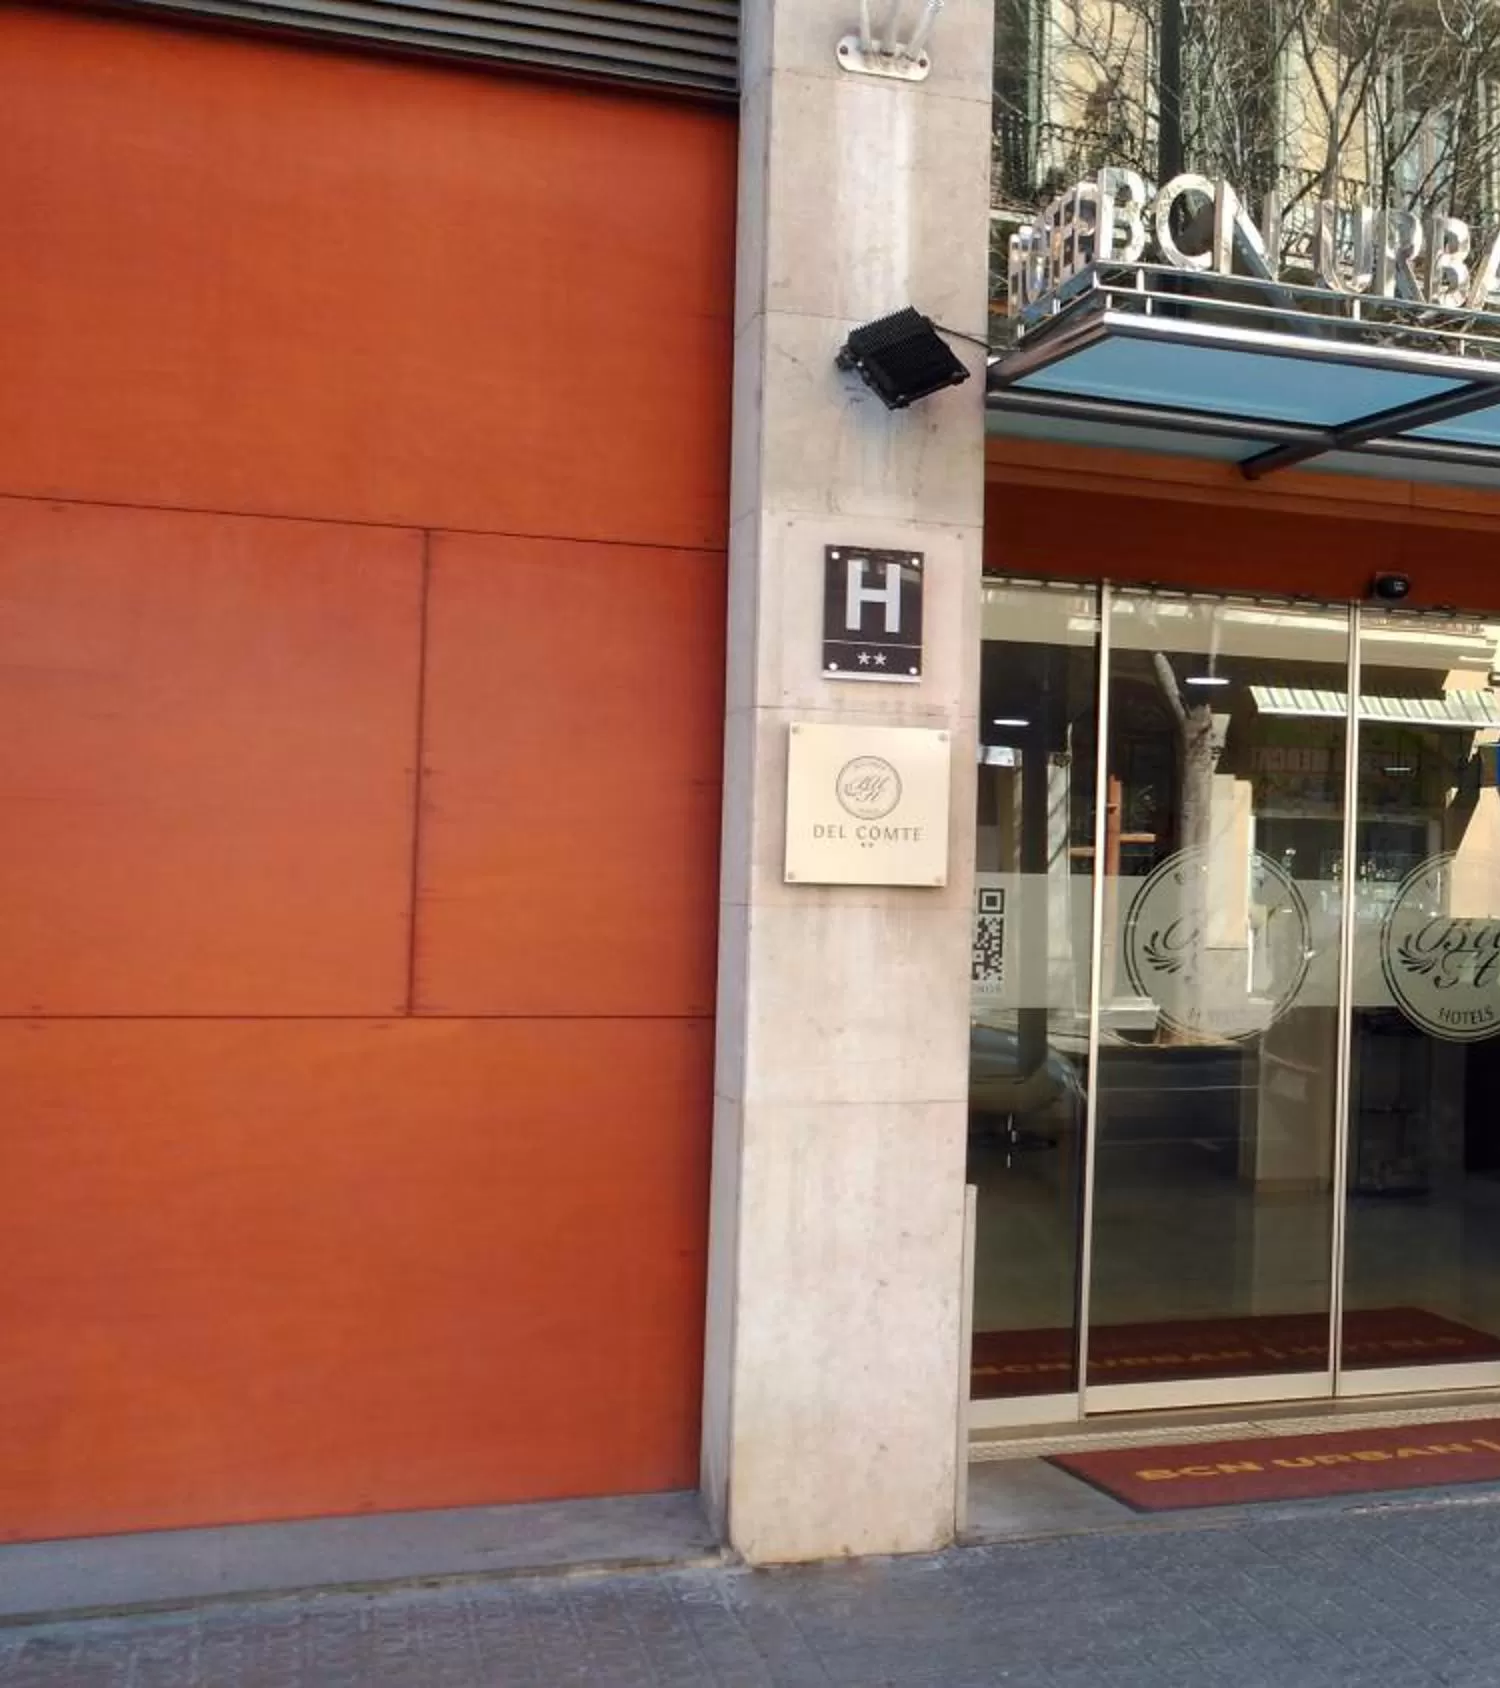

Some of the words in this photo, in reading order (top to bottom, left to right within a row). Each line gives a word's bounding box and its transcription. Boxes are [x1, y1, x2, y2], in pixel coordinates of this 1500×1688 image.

[1097, 167, 1281, 283] BCN
[845, 559, 900, 633] H
[813, 823, 847, 839] DEL
[855, 824, 924, 841] COMTE
[1438, 1003, 1495, 1026] HOTELS
[1136, 1460, 1265, 1481] BCN
[1271, 1443, 1473, 1468] URBAN
